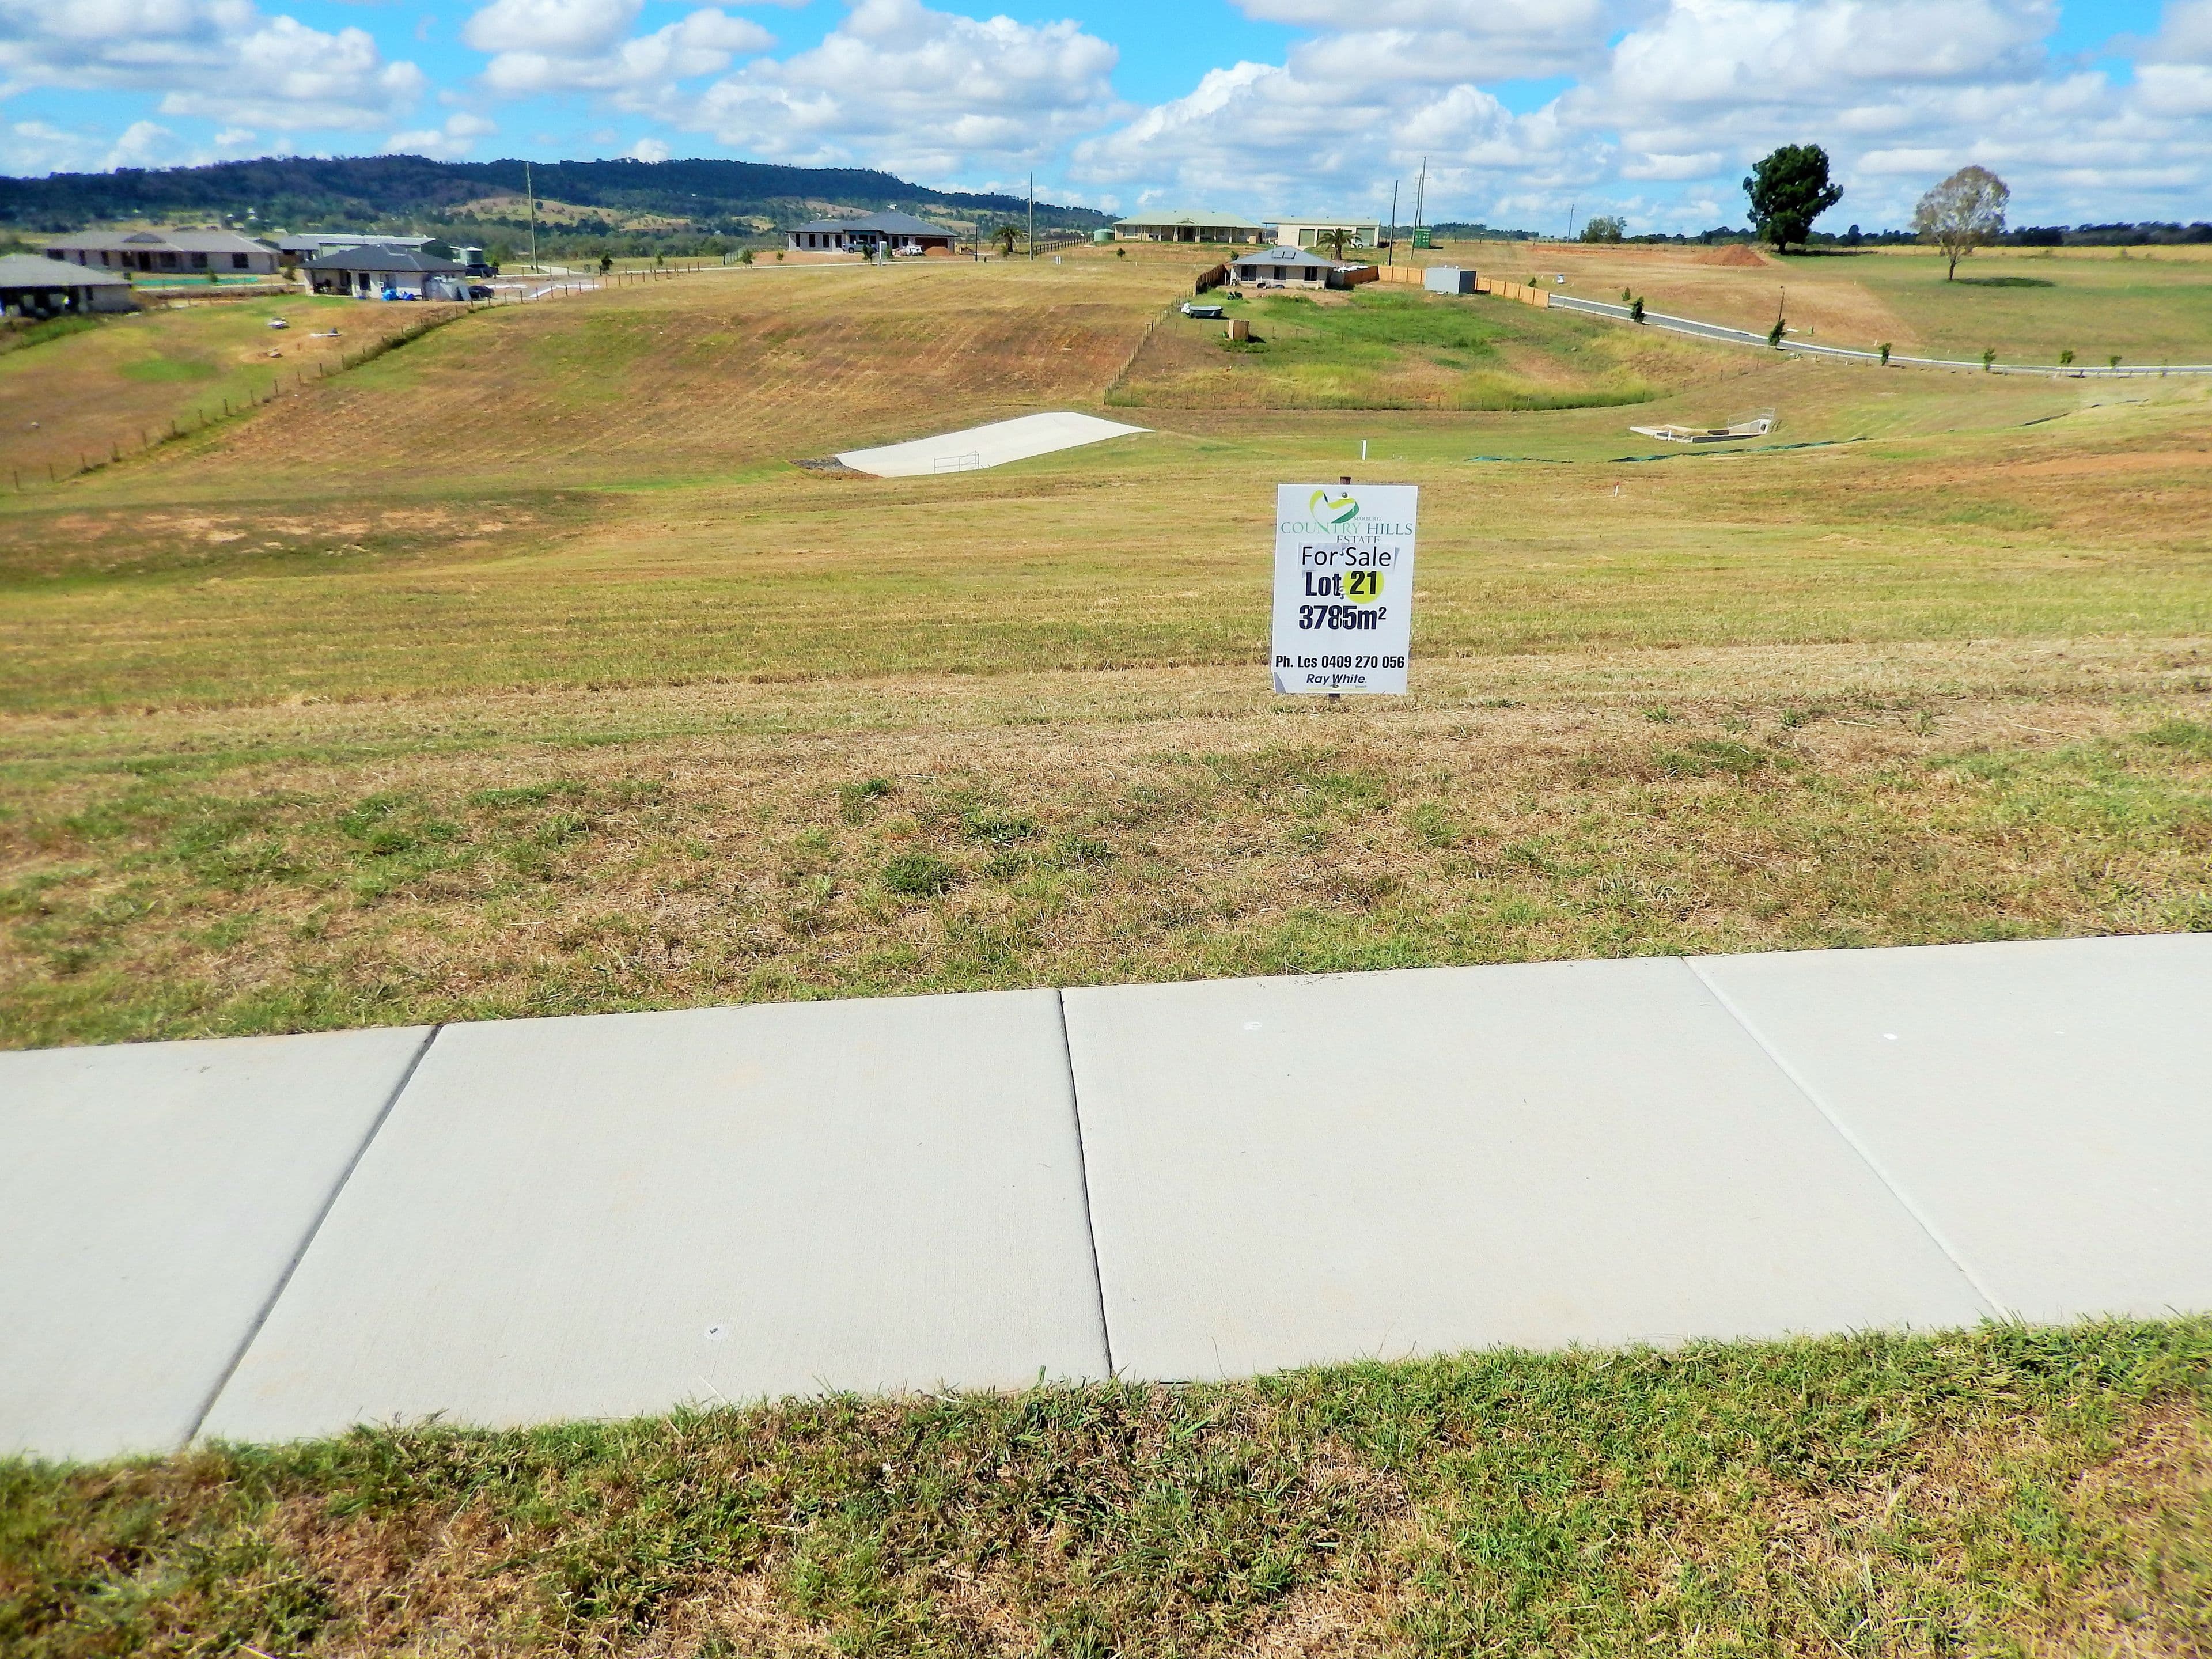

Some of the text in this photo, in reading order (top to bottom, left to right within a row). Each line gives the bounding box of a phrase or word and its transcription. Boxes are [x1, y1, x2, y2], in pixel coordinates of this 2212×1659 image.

[1281, 522, 1412, 535] COUNTRY HILLS
[1337, 535, 1381, 544] ESTATE
[1302, 546, 1391, 566] For Sale
[1305, 571, 1377, 596] Lot 21
[1275, 656, 1404, 668] Ph. Les 0409 270 056
[1306, 673, 1366, 685] Ray White
